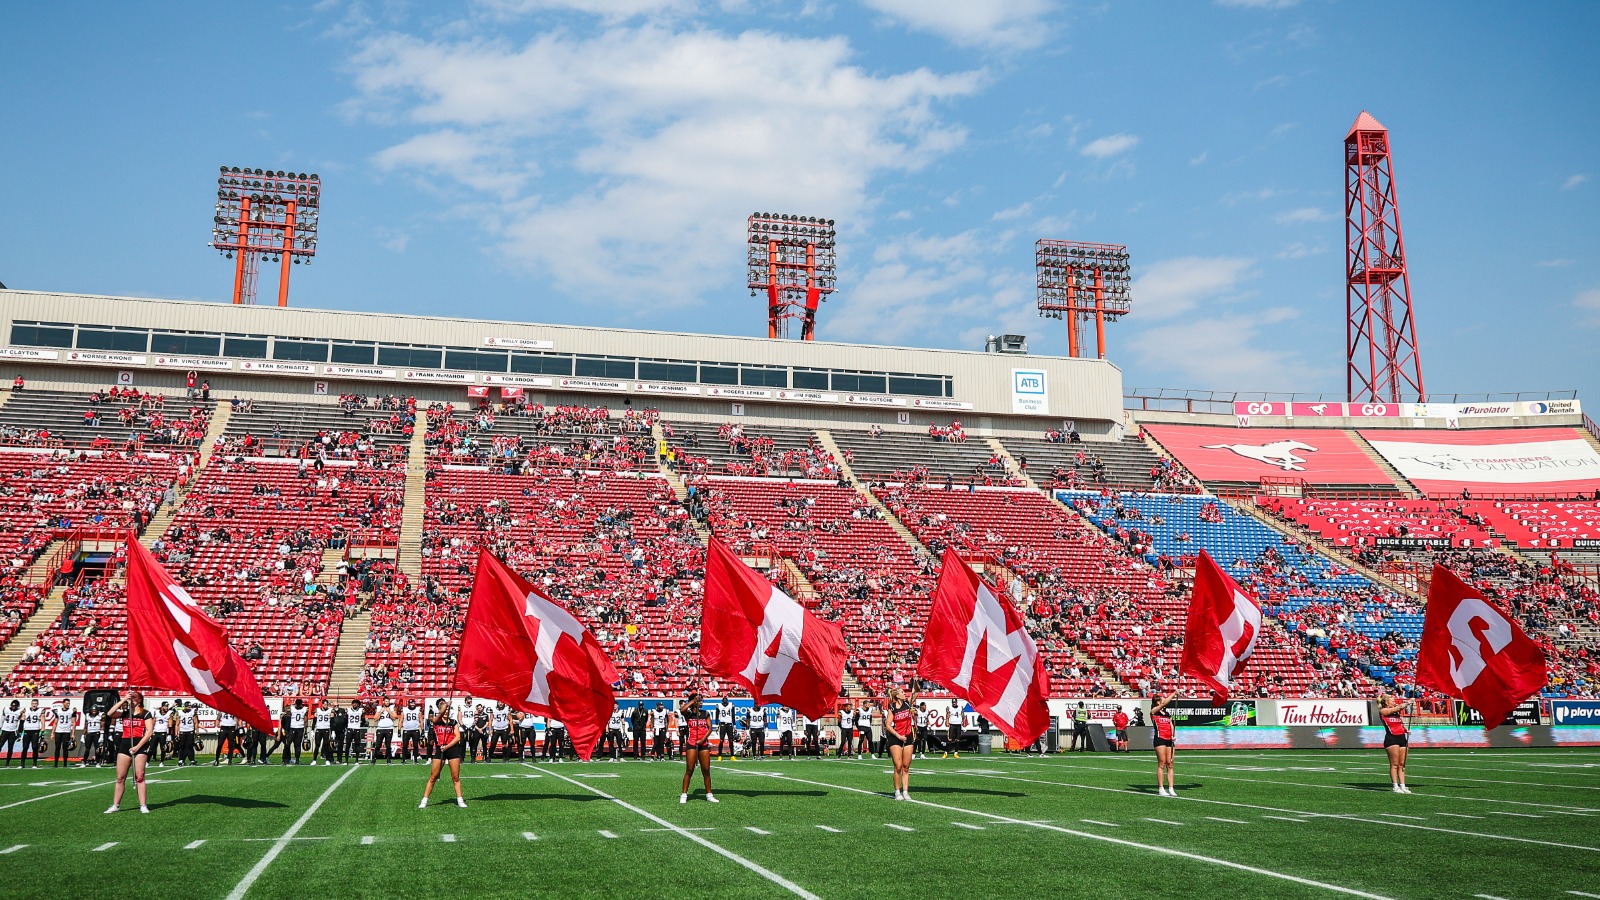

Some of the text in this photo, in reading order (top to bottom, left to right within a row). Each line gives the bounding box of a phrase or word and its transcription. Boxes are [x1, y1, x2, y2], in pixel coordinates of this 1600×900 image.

[121, 373, 130, 382] Q
[316, 383, 326, 392] R
[1021, 378, 1039, 388] ATB
[734, 404, 741, 413] T
[1248, 402, 1273, 415] GO
[1361, 404, 1387, 416] GO
[1468, 406, 1511, 415] Purolator
[900, 413, 907, 422] U
[1238, 417, 1249, 426] W
[1065, 422, 1073, 430] V
[1449, 419, 1457, 428] X
[1463, 457, 1598, 471] FOUNDATION
[1471, 455, 1552, 464] STAMPEDERS
[1401, 538, 1415, 546] SIX
[1417, 539, 1450, 547] STABLE
[739, 585, 805, 697] A
[1446, 598, 1513, 692] S
[525, 591, 586, 706] T
[951, 581, 1038, 728] M
[406, 712, 417, 721] 66
[1195, 708, 1212, 716] CITRUS
[1213, 708, 1227, 716] TASTE
[1281, 704, 1364, 724] Tim Hortons
[5, 715, 15, 723] 41
[26, 715, 38, 724] 49
[59, 715, 69, 724] 31
[181, 717, 193, 725] 42
[295, 713, 301, 722] 0
[349, 715, 360, 723] 29
[497, 713, 506, 722] 57
[611, 716, 620, 724] 32
